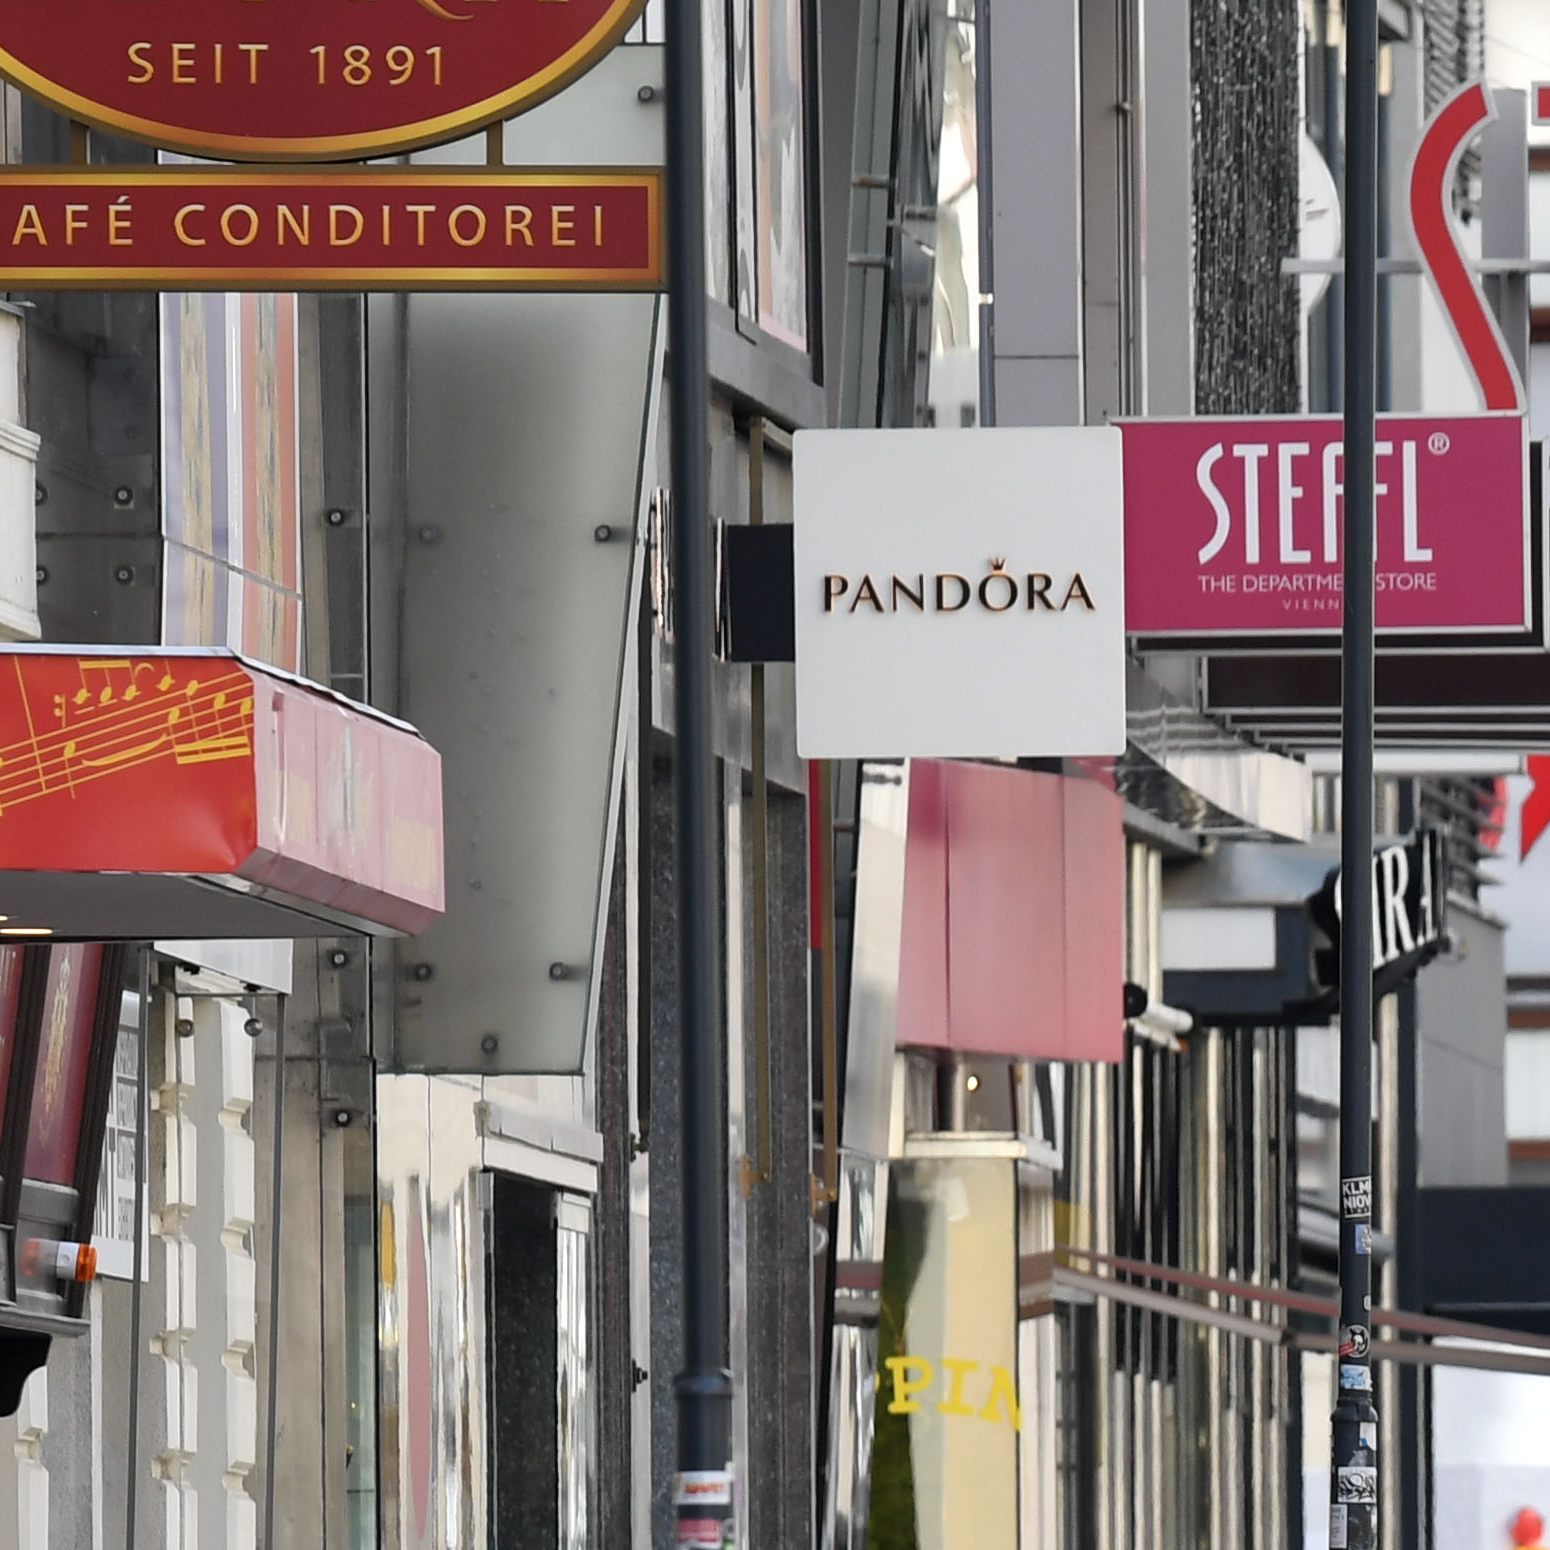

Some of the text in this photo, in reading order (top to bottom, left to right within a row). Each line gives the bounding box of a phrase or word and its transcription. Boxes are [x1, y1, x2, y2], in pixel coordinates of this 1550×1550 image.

[127, 42, 443, 86] SEIT 1891
[173, 203, 604, 247] CONDITOREI
[822, 572, 1096, 614] PANDORA
[1198, 572, 1437, 593] THE DEPARTME STORE
[1282, 599, 1344, 611] VIENN
[875, 1355, 1023, 1433] PIN
